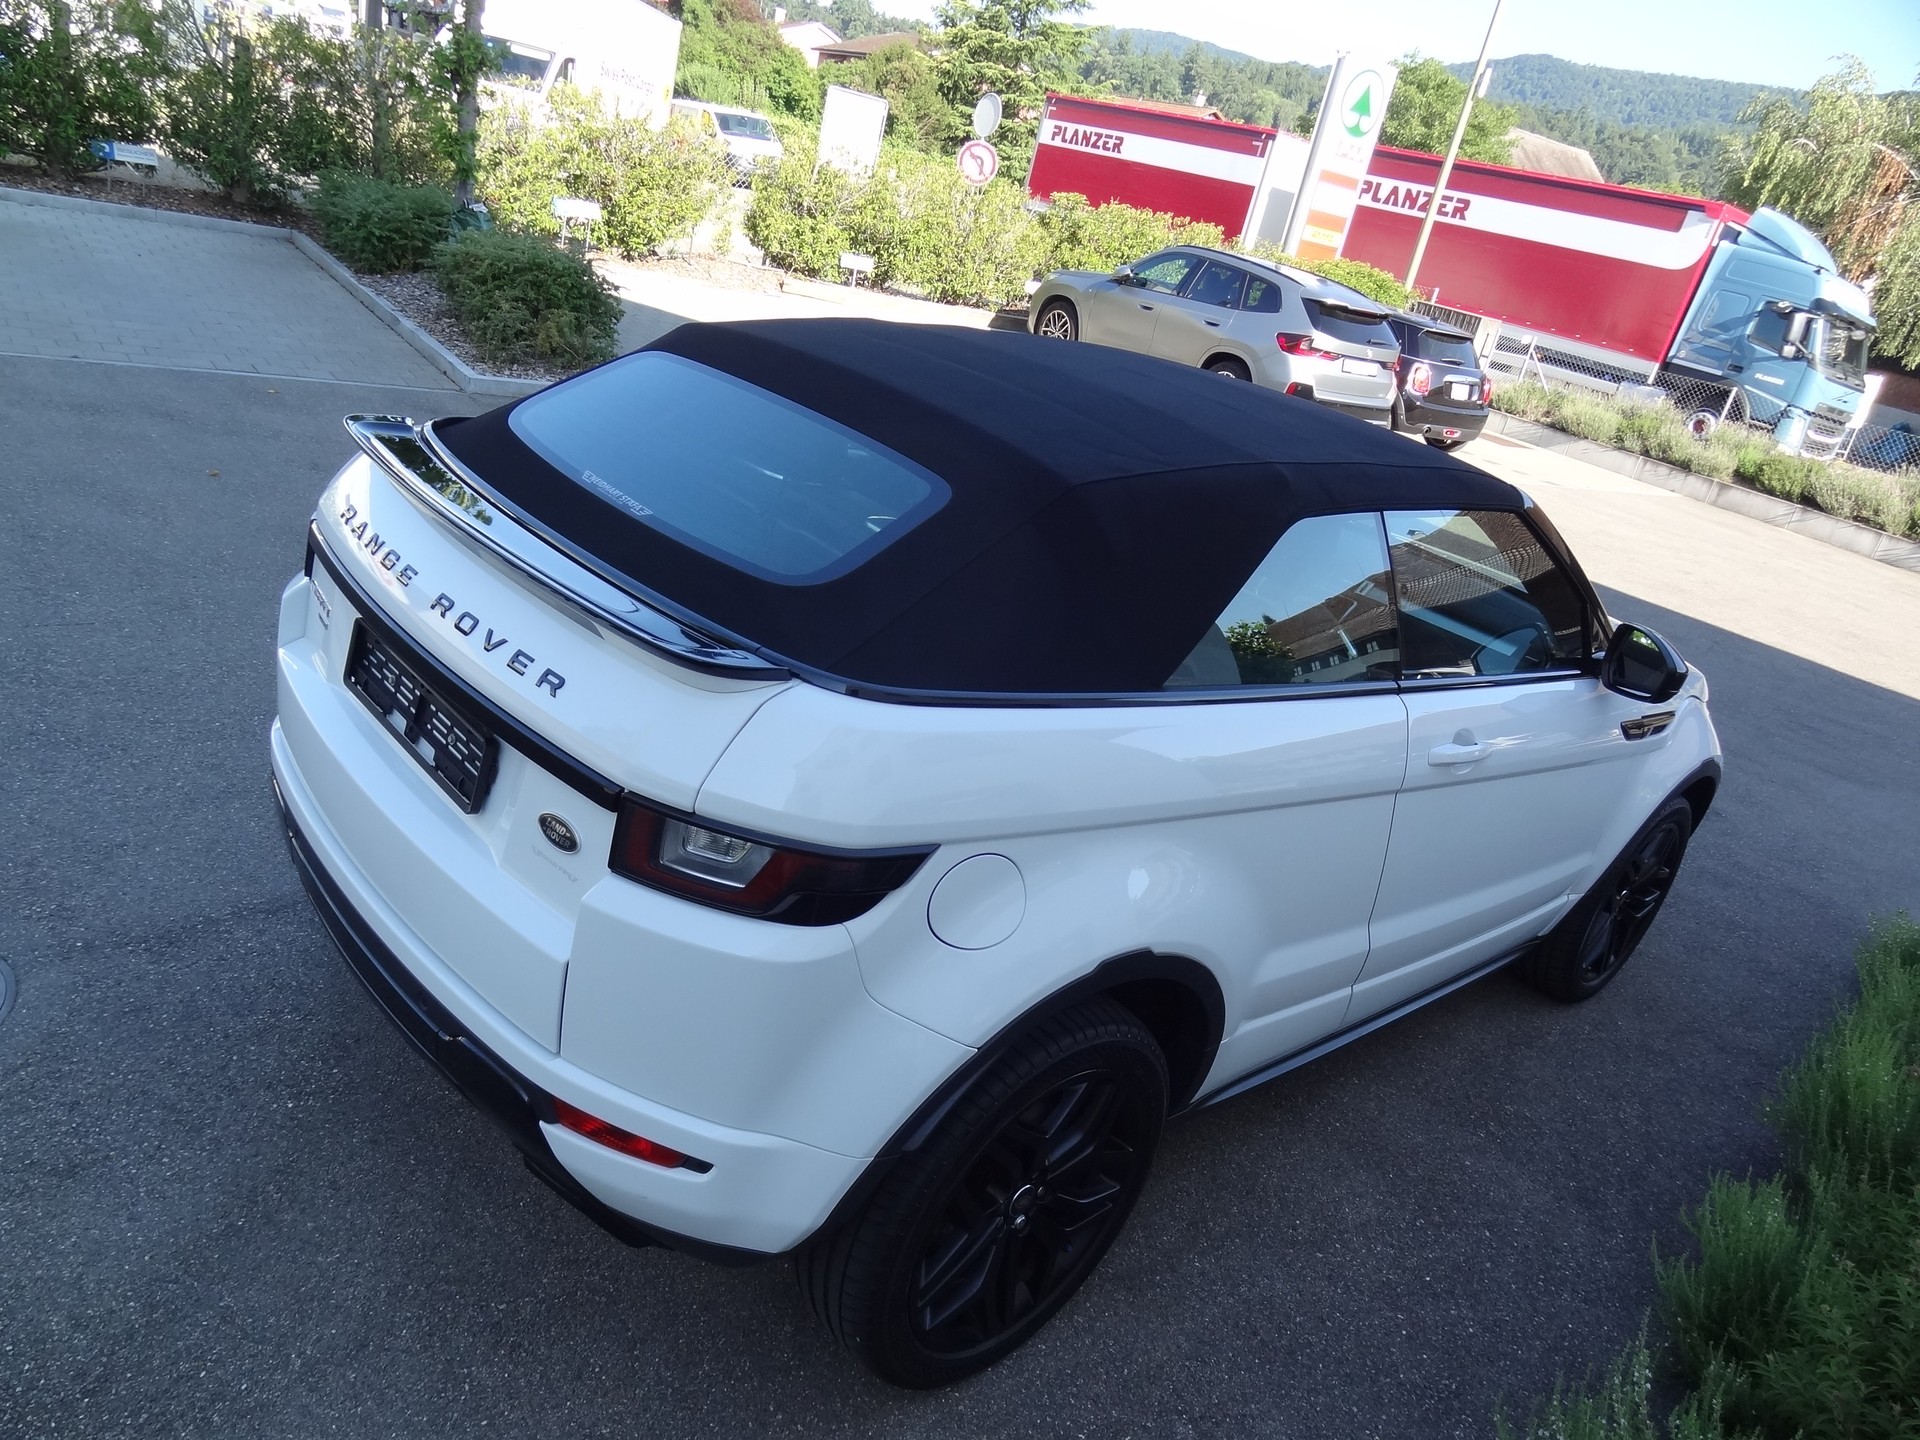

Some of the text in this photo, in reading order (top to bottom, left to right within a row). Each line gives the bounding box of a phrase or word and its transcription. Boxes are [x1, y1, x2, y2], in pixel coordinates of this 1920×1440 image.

[1050, 124, 1125, 154] PLANZER
[1358, 180, 1472, 221] PLANZER
[588, 472, 623, 498] NEIDHART
[340, 504, 418, 587] RANGE
[430, 592, 566, 698] ROVER
[546, 817, 567, 836] LAND
[546, 829, 571, 848] ROVER
